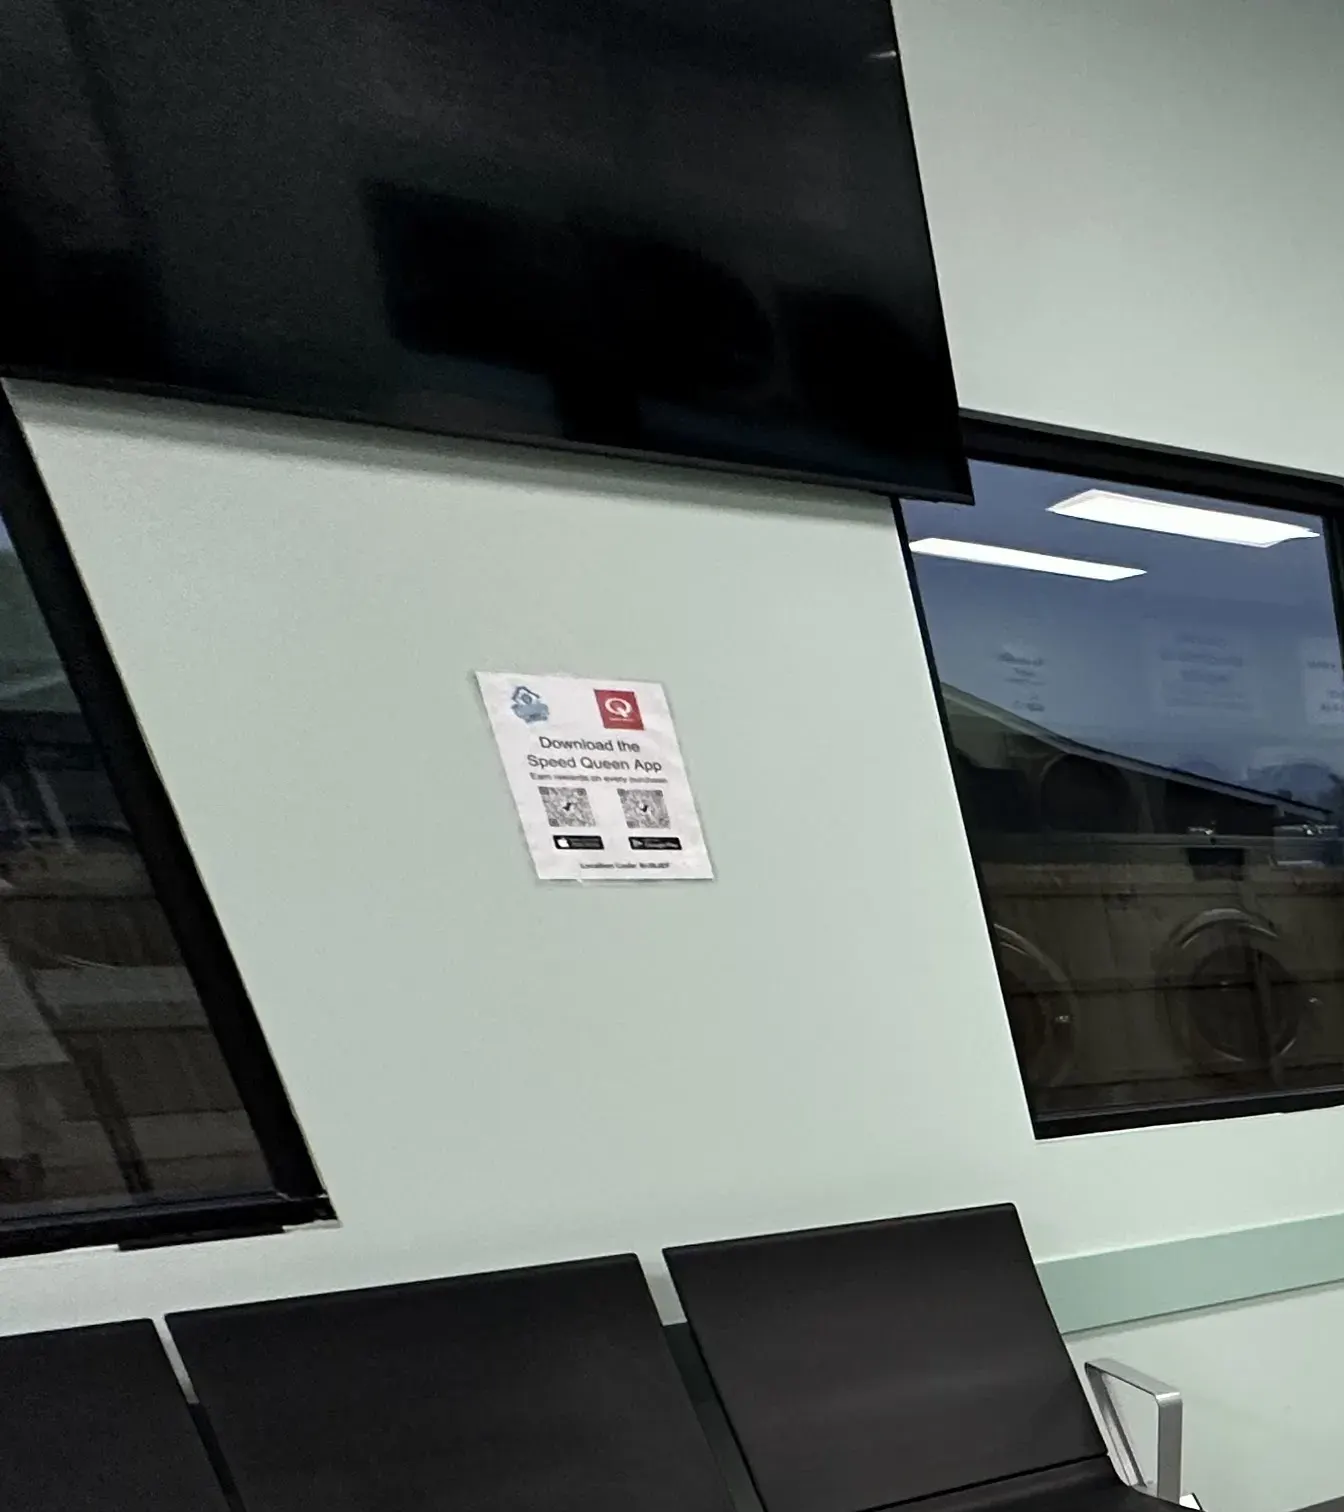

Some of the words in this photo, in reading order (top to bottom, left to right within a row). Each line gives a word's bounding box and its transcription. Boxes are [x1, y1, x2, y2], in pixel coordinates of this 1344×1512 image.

[604, 697, 633, 718] Q
[538, 736, 614, 751] Download
[617, 739, 640, 752] the
[527, 754, 577, 769] Speed
[580, 756, 630, 770] Queen
[634, 759, 662, 773] App
